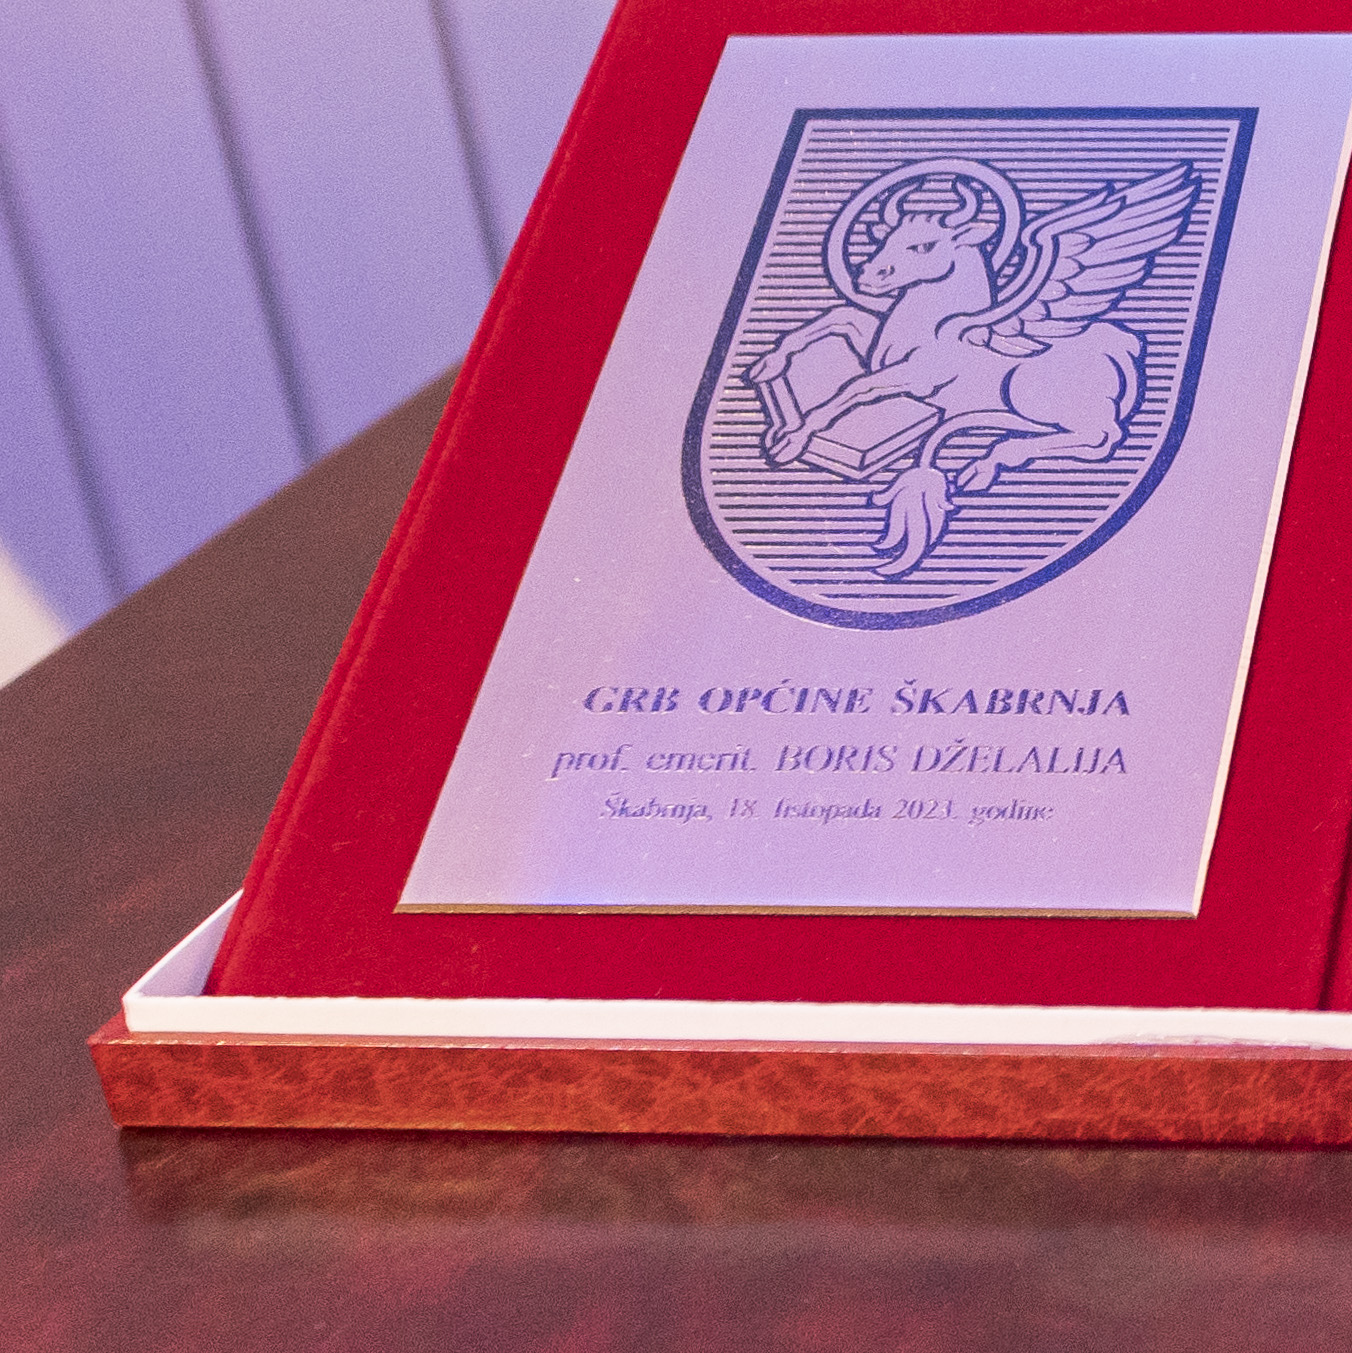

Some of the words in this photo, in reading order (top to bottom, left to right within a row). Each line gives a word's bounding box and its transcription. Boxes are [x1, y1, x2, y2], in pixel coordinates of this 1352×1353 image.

[582, 685, 680, 715] GRB
[698, 679, 874, 715] OPĆINE
[892, 679, 1132, 717] ŠKABRNJA
[548, 743, 628, 780] prof.
[646, 744, 756, 774] emerit.
[775, 745, 898, 774] BORIS
[911, 738, 1129, 776] DŽELALIJA
